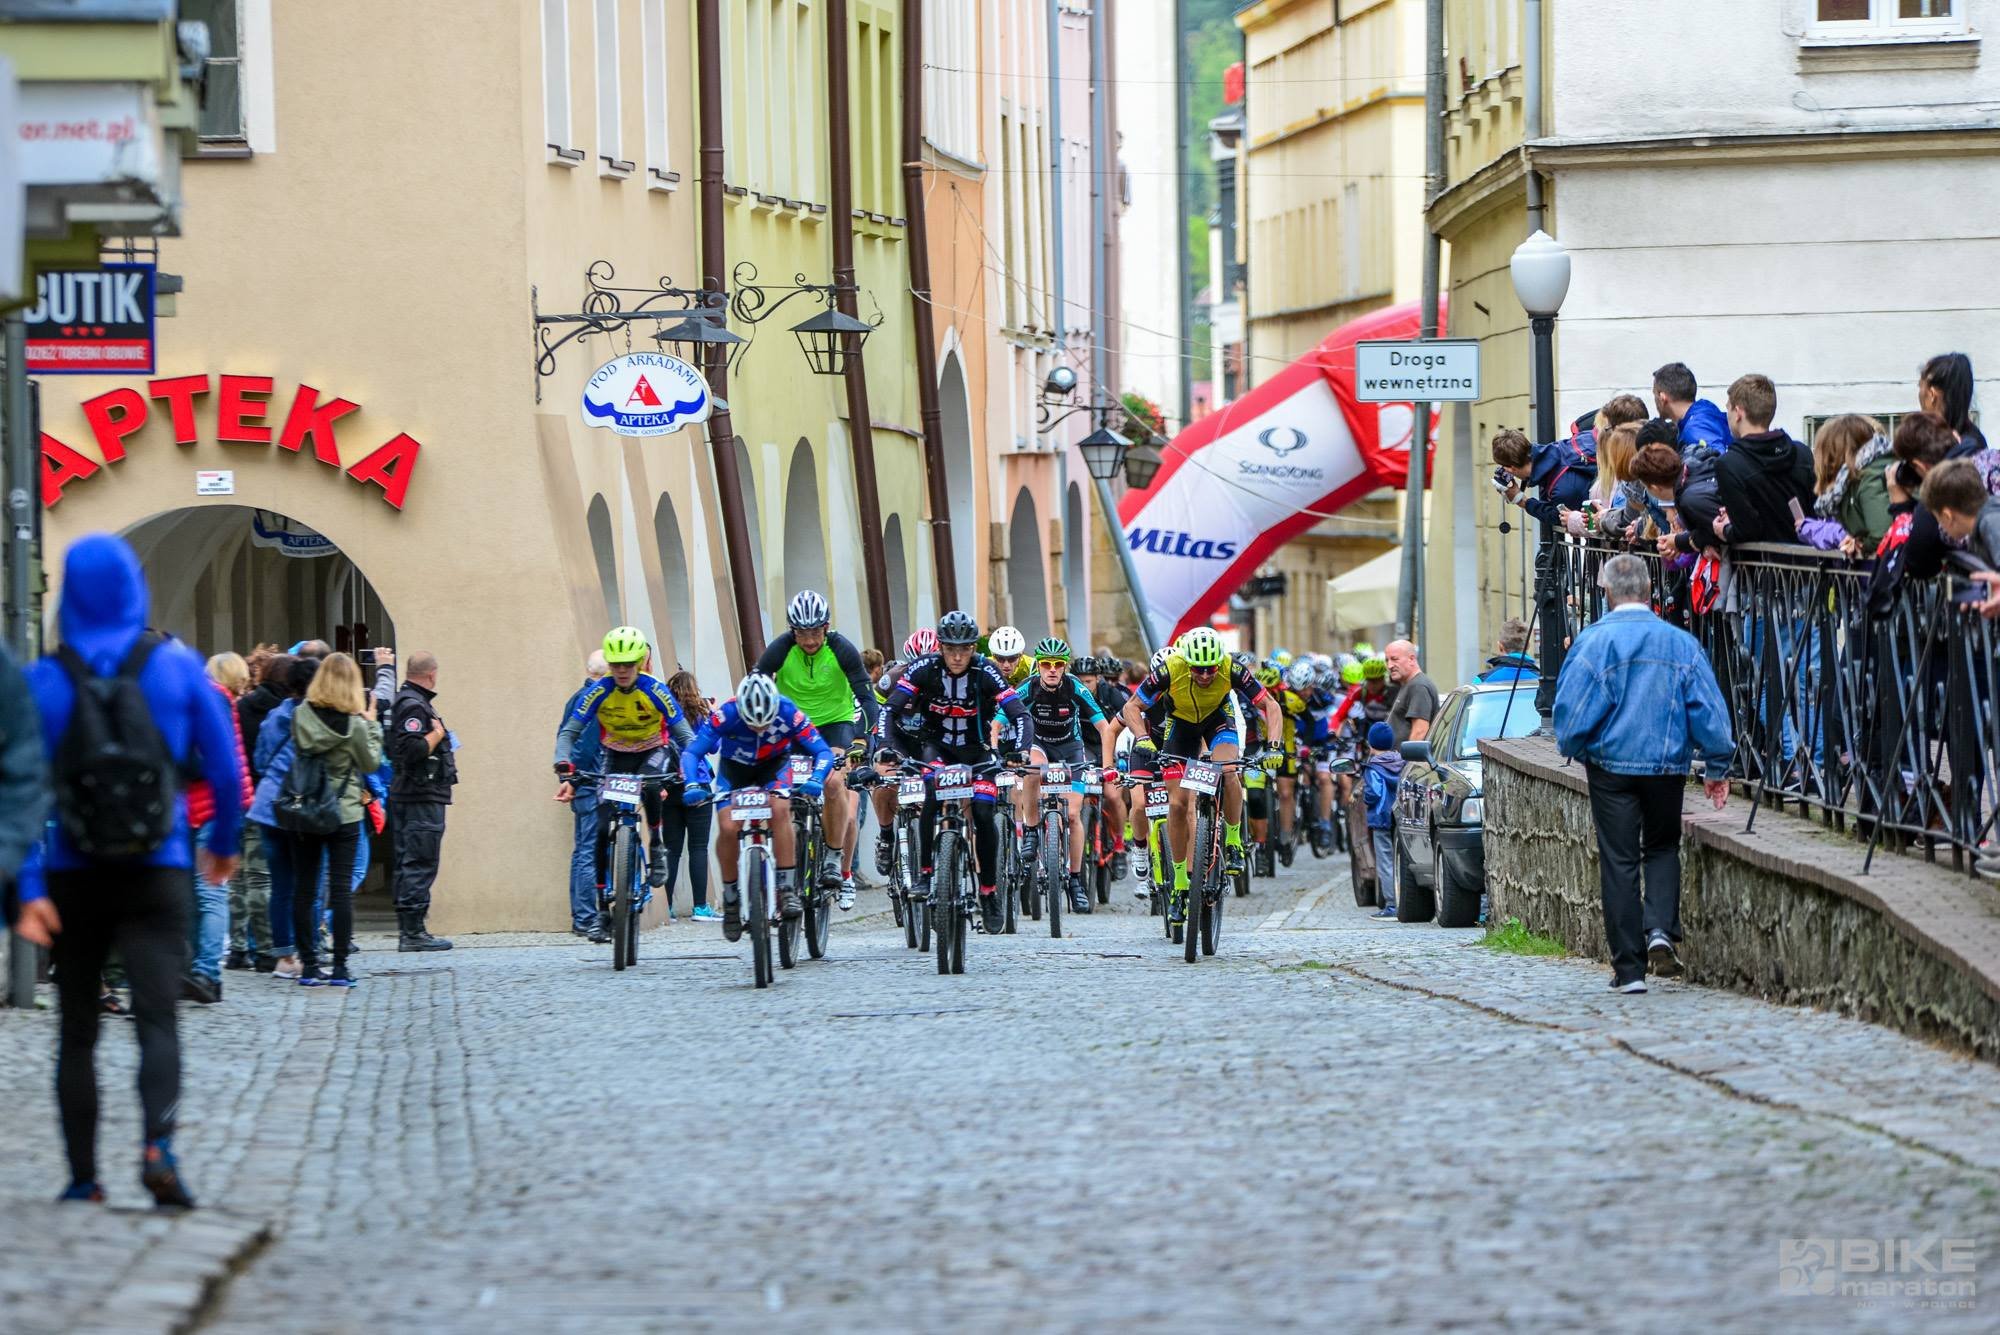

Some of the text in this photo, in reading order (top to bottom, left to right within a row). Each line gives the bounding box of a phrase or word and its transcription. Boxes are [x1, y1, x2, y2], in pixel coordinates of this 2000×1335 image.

[1390, 352, 1446, 370] Droga
[591, 355, 698, 389] POD ARKADAMI
[1364, 376, 1472, 393] wewnętrzna
[620, 414, 669, 426] APTEKA
[40, 374, 422, 510] APTEKA
[288, 536, 328, 546] APTEK
[1128, 528, 1237, 560] Mitas
[939, 772, 967, 786] 2841
[1046, 771, 1066, 783] 980
[1187, 768, 1216, 783] 3655
[610, 780, 637, 793] 1205
[736, 793, 766, 806] 1239
